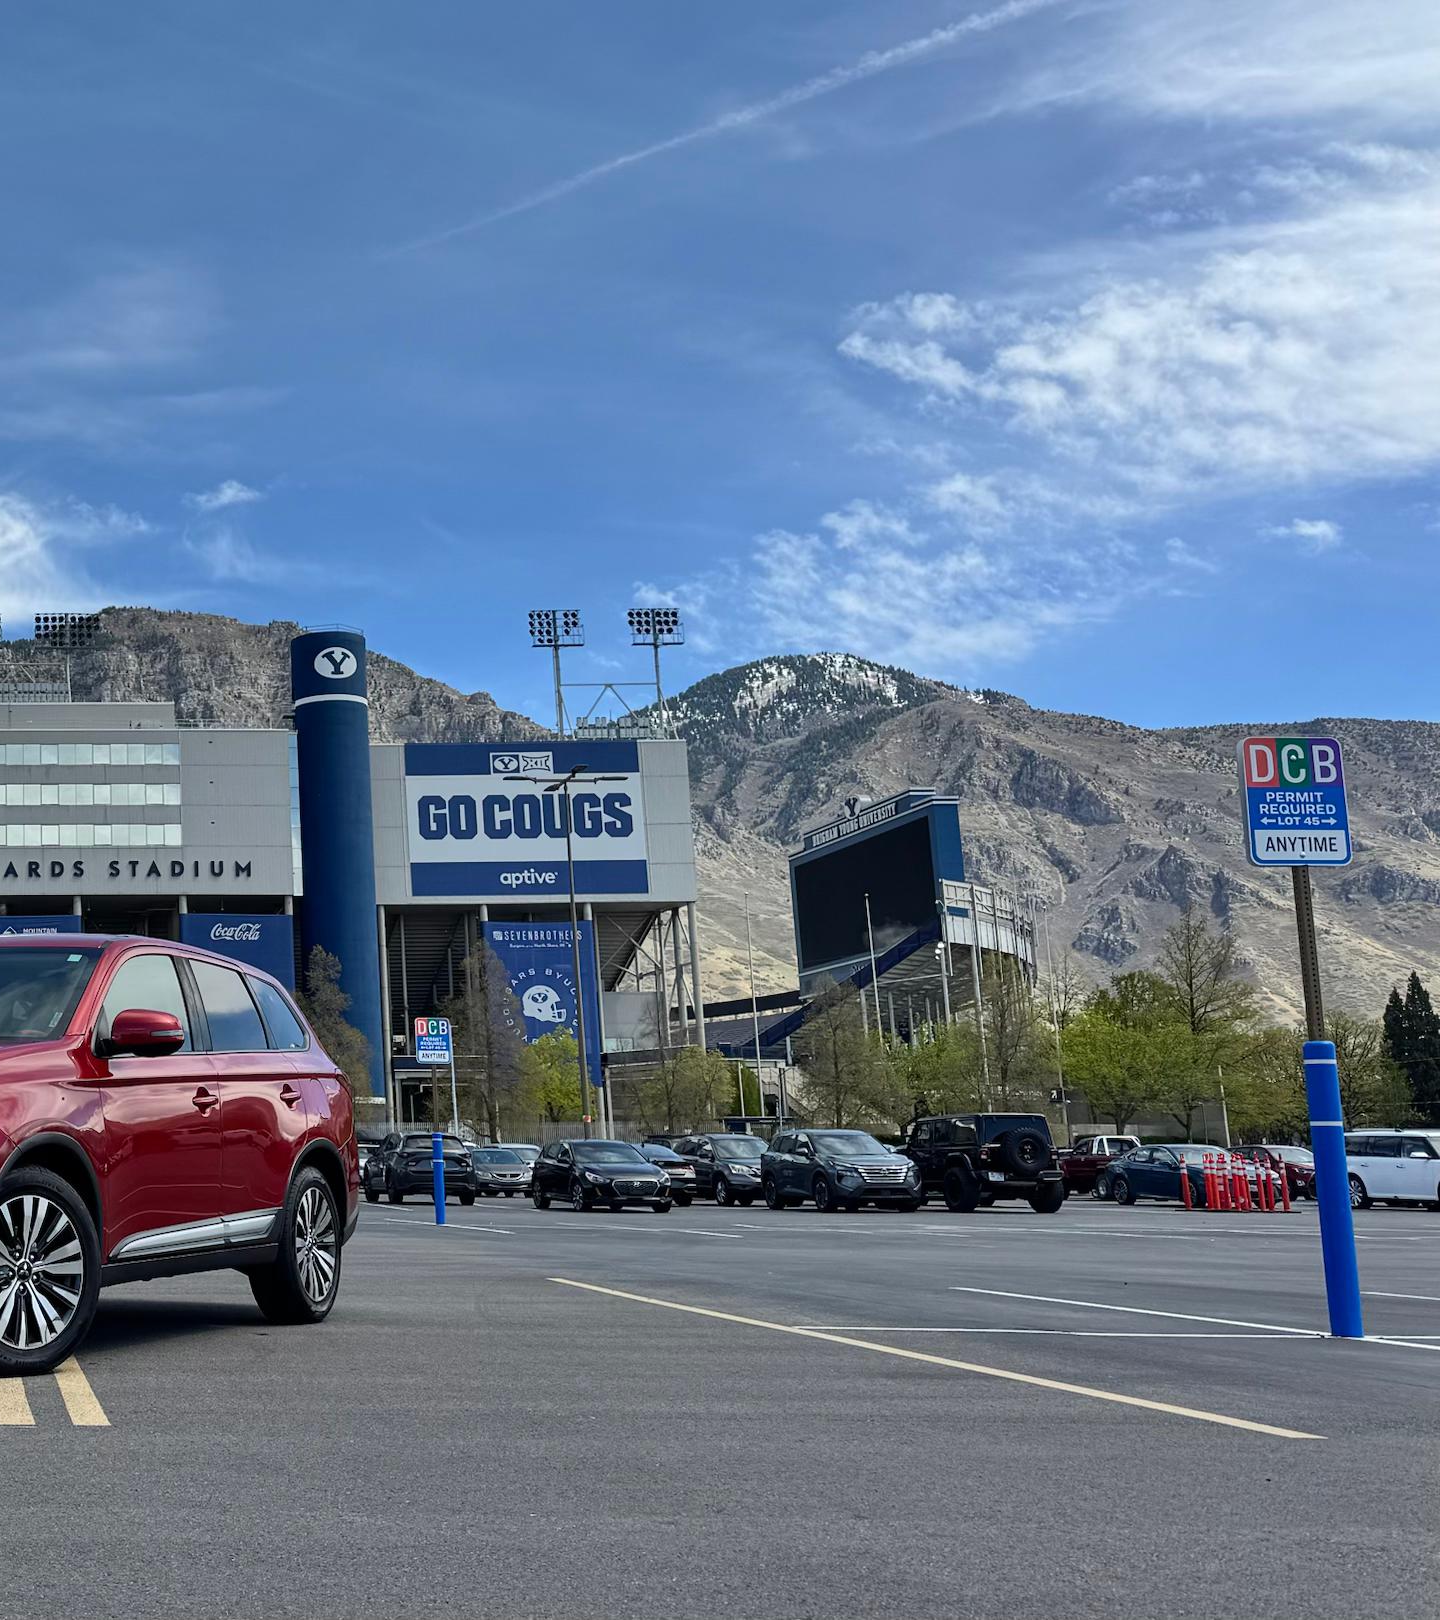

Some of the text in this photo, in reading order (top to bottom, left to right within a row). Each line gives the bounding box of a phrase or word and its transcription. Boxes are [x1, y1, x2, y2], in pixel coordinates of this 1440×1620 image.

[1249, 744, 1338, 784] DCB
[1265, 791, 1324, 803] PERMIT
[417, 792, 634, 840] GO COUGS
[858, 802, 897, 828] UNIVERSITY
[1259, 804, 1336, 815] REQUIRED
[1278, 816, 1320, 826] LOT 45
[1265, 836, 1338, 853] ANYTIME
[109, 859, 254, 878] STADIUM
[499, 867, 558, 888] aptive
[210, 922, 262, 941] Coca-Cola
